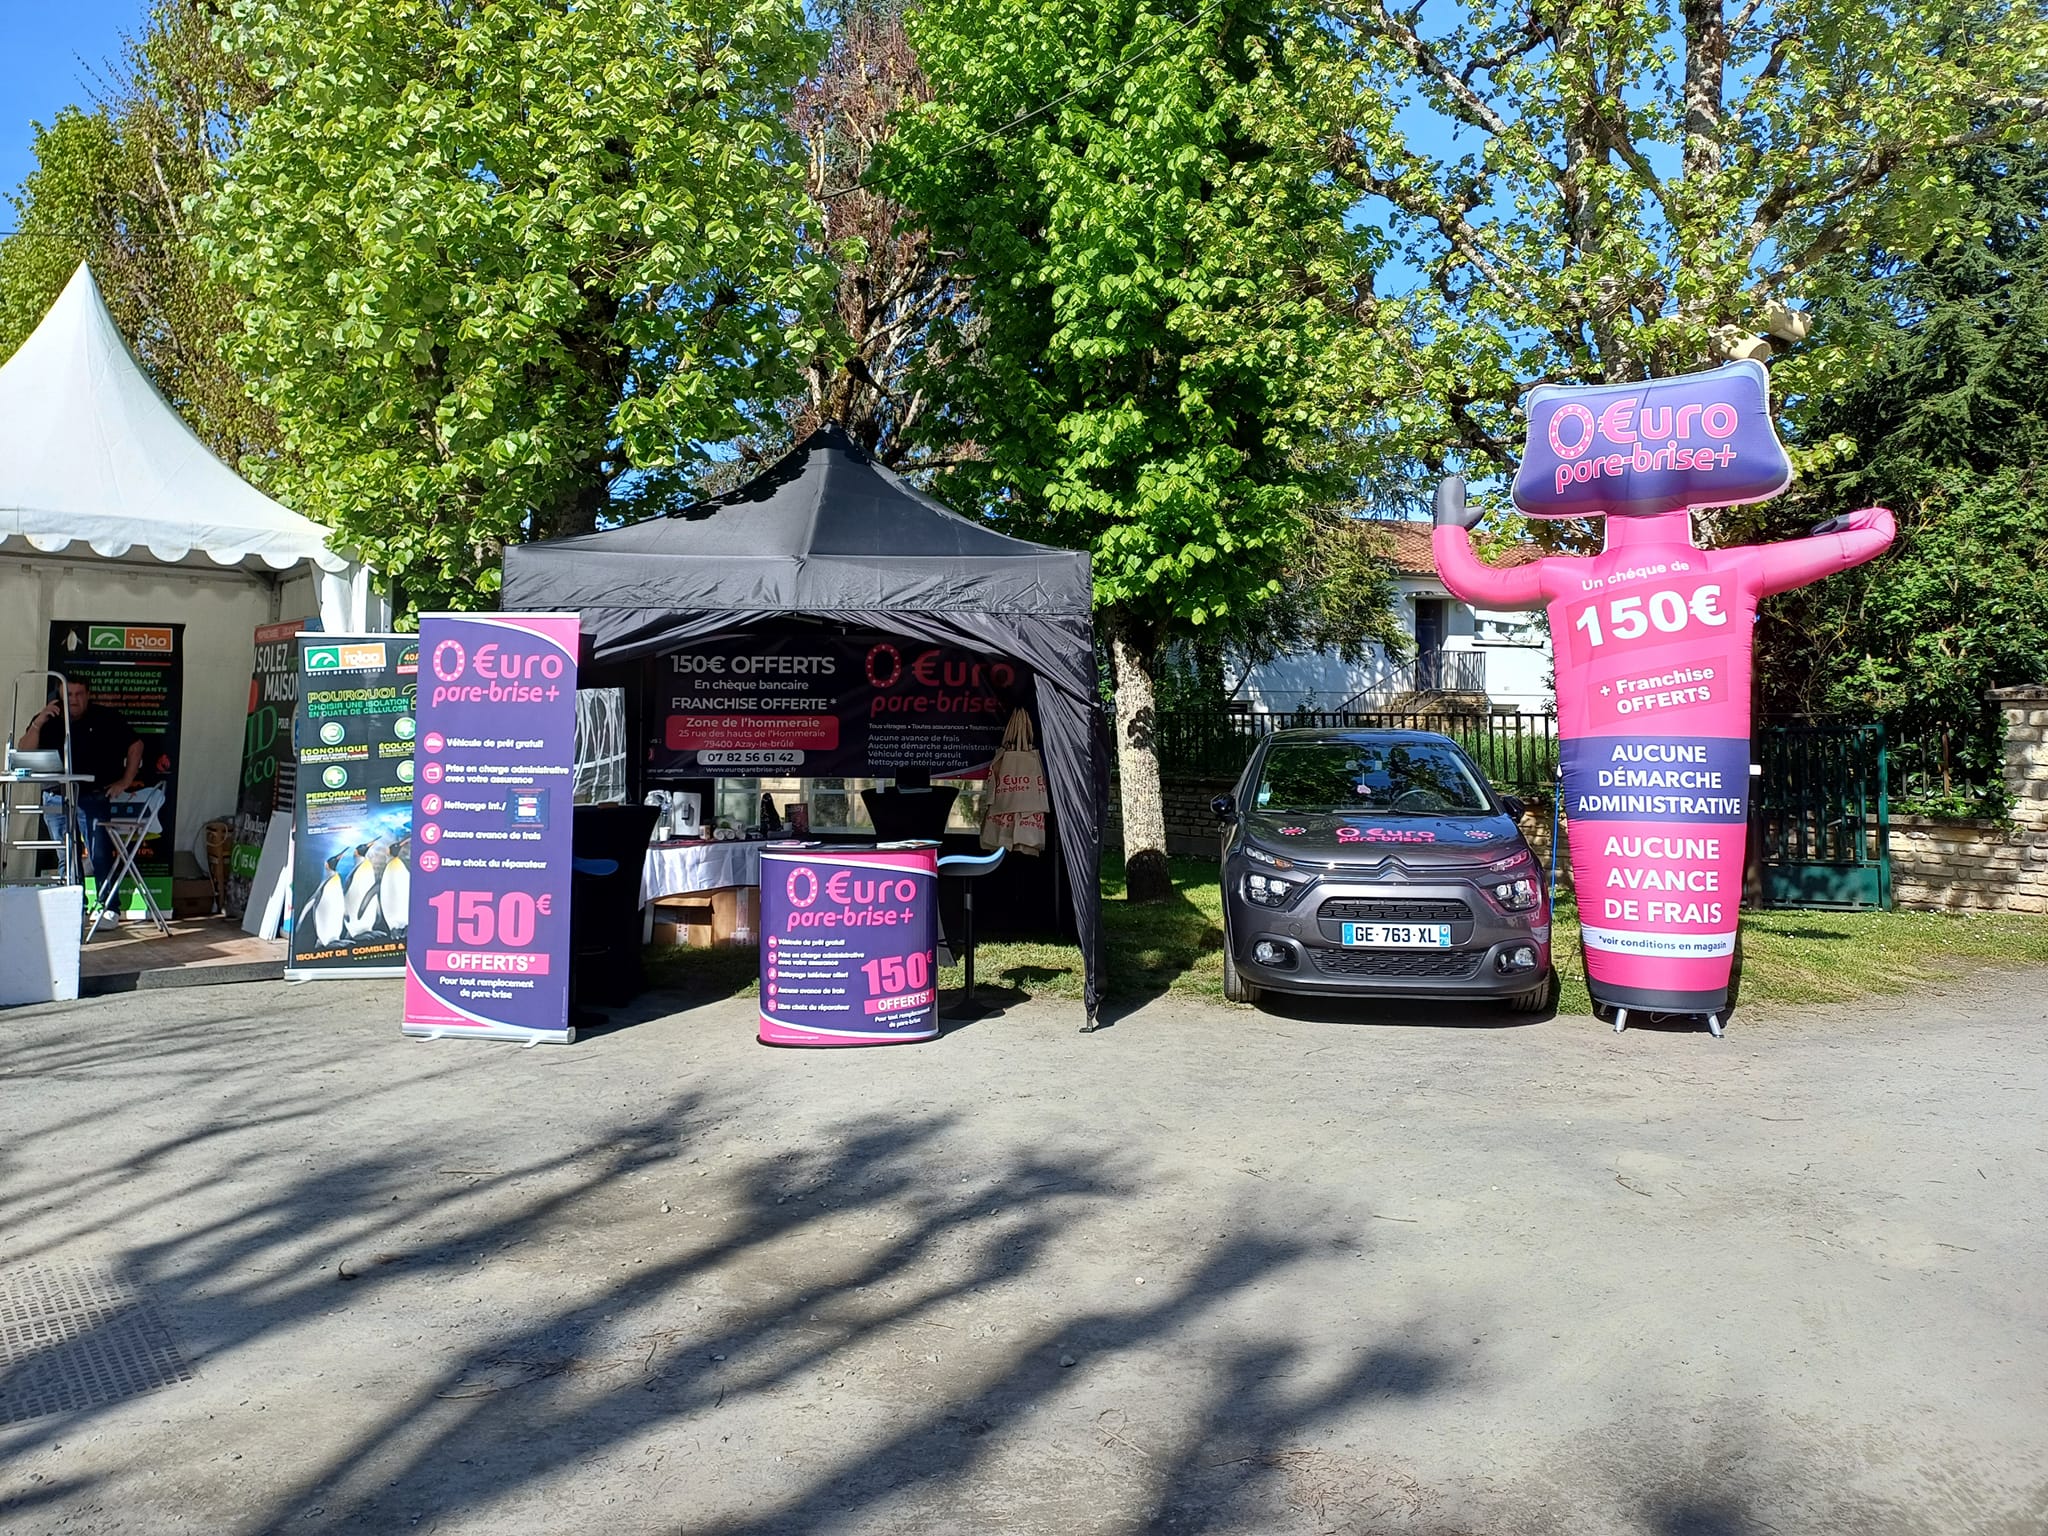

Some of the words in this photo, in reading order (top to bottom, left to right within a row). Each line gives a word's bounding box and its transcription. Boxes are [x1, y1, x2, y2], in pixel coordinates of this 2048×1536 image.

[1581, 578, 1604, 591] Un
[1671, 560, 1690, 571] de
[1576, 585, 1728, 647] 150€
[131, 634, 167, 649] igloo
[252, 643, 288, 673] ISOLEZ
[473, 643, 563, 679] €uro
[671, 655, 726, 673] 150€
[731, 656, 836, 674] OFFERTS
[694, 680, 709, 689] En
[712, 680, 757, 691] chèque
[759, 680, 809, 690] bancaire
[1600, 685, 1611, 696] +
[1615, 667, 1715, 695] Franchise
[307, 687, 396, 703] POURQUOI
[1616, 686, 1711, 714] OFFERTS
[308, 702, 343, 711] CHOISIR
[366, 698, 409, 708] ISOLATION
[671, 697, 757, 710] FRANCHISE
[761, 698, 827, 710] OFFERTE
[321, 709, 349, 717] OUATE
[363, 705, 408, 714] CELLULOSE
[686, 718, 718, 727] Zone
[722, 718, 737, 727] de
[741, 717, 820, 728] l'hommeraie
[708, 730, 725, 738] des
[726, 730, 752, 738] hauts
[754, 730, 765, 738] de
[868, 734, 899, 742] Aucune
[943, 734, 960, 742] frais
[300, 744, 368, 756] ÉCONOMIQUE
[446, 738, 482, 747] Véhicule
[497, 739, 514, 749] prêt
[516, 740, 544, 749] gratuit
[704, 740, 732, 748] 79400
[868, 742, 899, 750] Aucune
[901, 742, 942, 750] démarche
[707, 753, 721, 762] 07
[727, 753, 741, 762] 82
[745, 753, 759, 762] 56
[763, 753, 775, 762] 61
[778, 753, 794, 762] 42
[916, 750, 933, 760] prêt
[934, 752, 961, 760] gratuit
[1611, 744, 1708, 763] AUCUNE
[445, 764, 464, 773] Prise
[478, 765, 509, 775] charge
[511, 765, 570, 775] administrative
[868, 759, 909, 768] Nettoyage
[911, 758, 945, 766] intérieur
[947, 759, 968, 767] offert
[467, 775, 489, 783] votre
[490, 776, 534, 784] assurance
[1598, 767, 1722, 789] DÉMARCHE
[306, 789, 366, 800] PERFORMANT
[444, 801, 486, 812] Nettoyage
[1578, 796, 1741, 815] ADMINISTRATIVE
[442, 829, 474, 839] Aucune
[476, 831, 508, 840] avance
[509, 831, 521, 840] de
[522, 831, 541, 841] frais
[1603, 836, 1720, 860] AUCUNE
[441, 858, 461, 867] Libre
[462, 859, 487, 868] choix
[489, 859, 500, 868] du
[501, 859, 547, 870] réparateur
[1606, 868, 1719, 892] AVANCE
[825, 870, 917, 904] €uro
[428, 890, 552, 946] 150€
[1605, 899, 1640, 921] DE
[1647, 900, 1722, 924] FRAIS
[296, 951, 333, 961] ISOLANT
[335, 949, 348, 957] DE
[352, 944, 396, 954] COMBLES
[1621, 940, 1676, 950] conditions
[1678, 942, 1691, 950] en
[1693, 941, 1727, 953] magasin
[861, 950, 933, 995] 150€
[439, 976, 458, 986] Pour
[460, 978, 476, 986] tout
[477, 978, 534, 989] remplacement
[459, 988, 470, 998] de
[471, 989, 513, 1000] pare-brise
